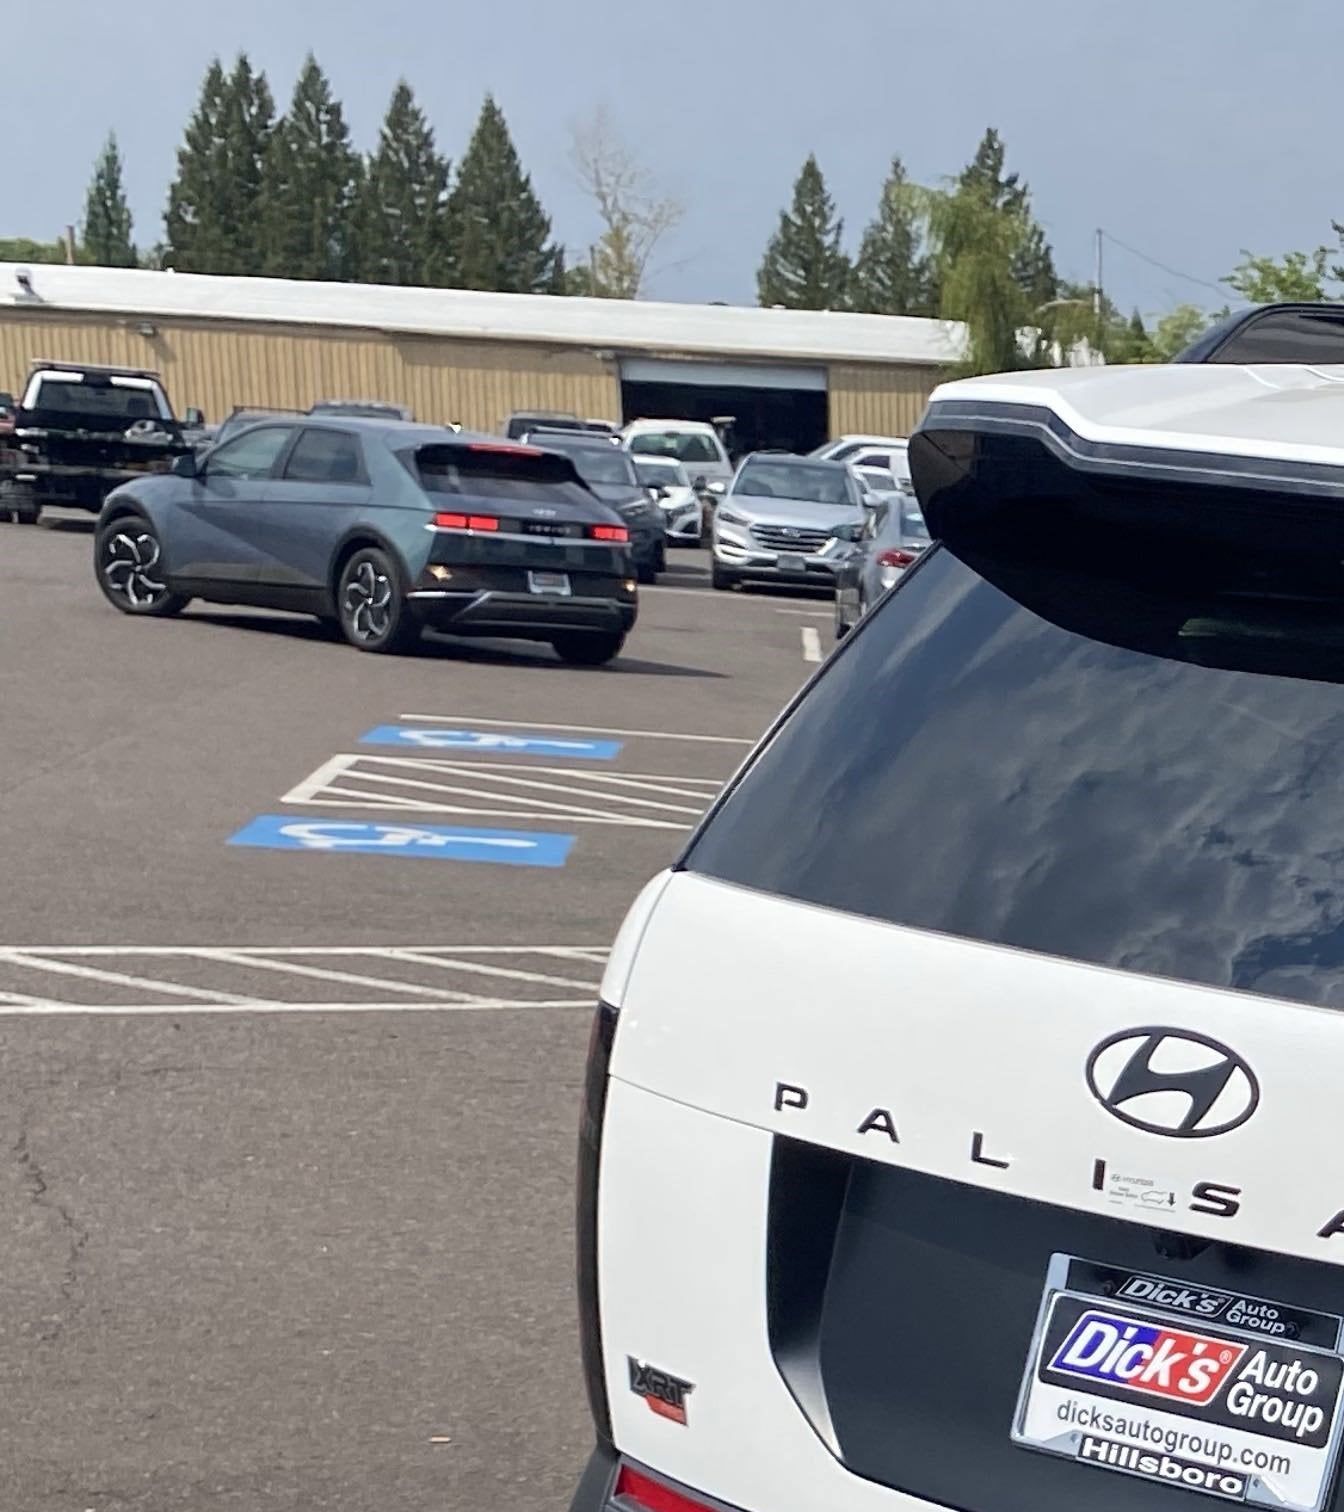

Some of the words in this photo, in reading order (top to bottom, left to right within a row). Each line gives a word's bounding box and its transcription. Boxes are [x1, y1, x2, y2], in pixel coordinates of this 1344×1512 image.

[1124, 1279, 1219, 1313] Dick's
[1232, 1300, 1279, 1319] Auto
[1226, 1311, 1285, 1334] Group
[1239, 1350, 1318, 1395] Auto
[1226, 1382, 1324, 1437] Group
[1056, 1399, 1291, 1475] dicksautogroup.com
[1081, 1437, 1244, 1495] Hillsboro
